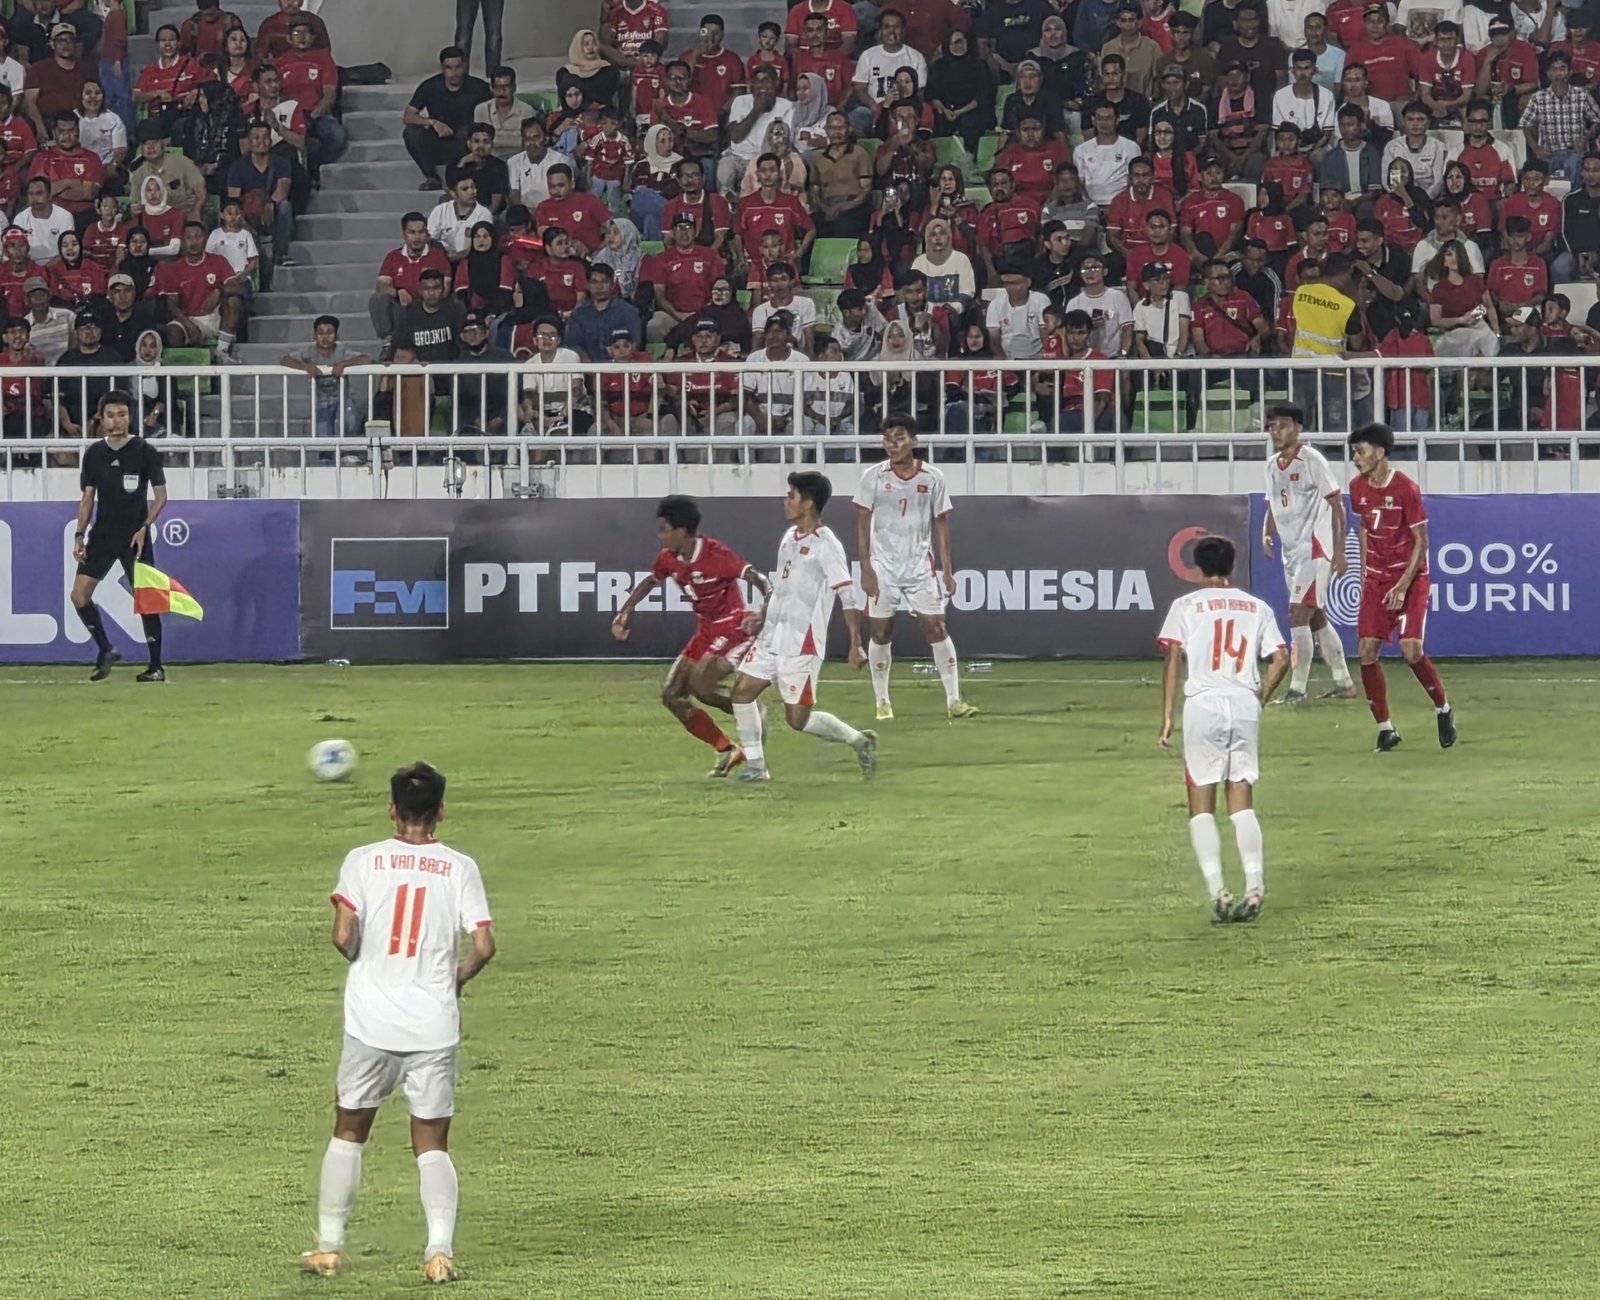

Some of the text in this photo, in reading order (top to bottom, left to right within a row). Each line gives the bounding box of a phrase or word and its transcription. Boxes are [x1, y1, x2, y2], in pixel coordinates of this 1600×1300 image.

[1297, 293, 1340, 311] STEWARD
[899, 498, 907, 517] 7
[1371, 509, 1381, 529] 7
[1437, 542, 1558, 575] 00%
[464, 562, 550, 613] PT
[852, 560, 1155, 611] IONESIA
[1429, 582, 1570, 612] URNI
[1398, 614, 1407, 635] 7
[1212, 617, 1248, 674] 14
[390, 854, 415, 870] VAN
[419, 856, 452, 877] BACH
[388, 883, 427, 959] 11
